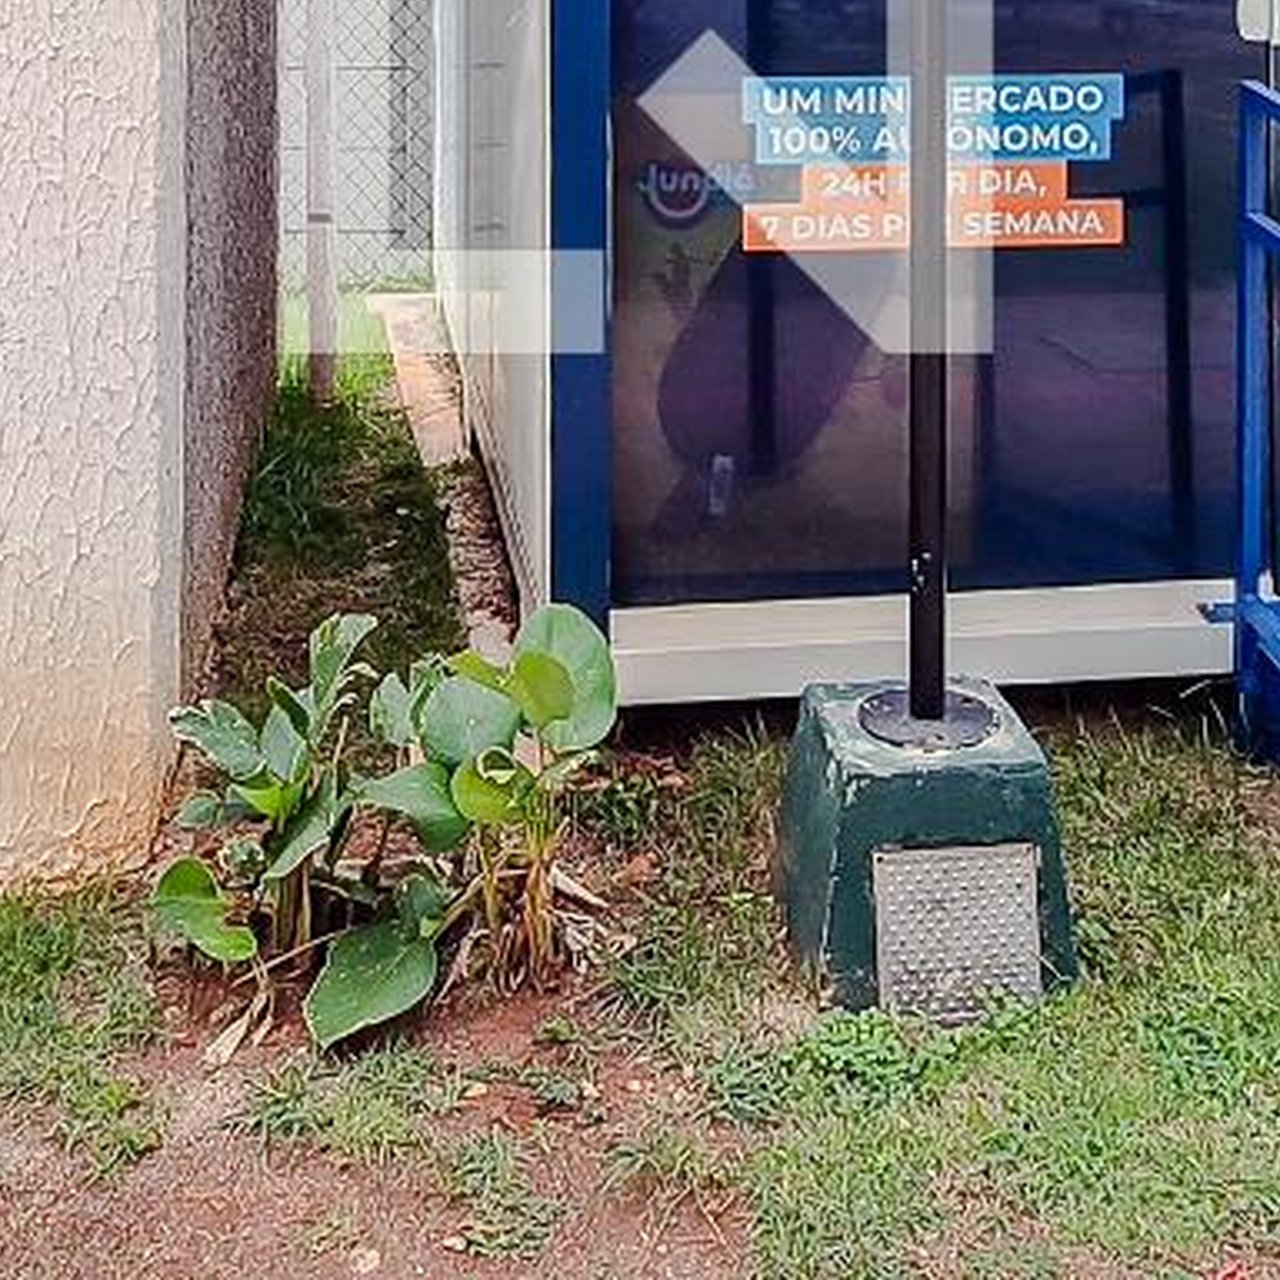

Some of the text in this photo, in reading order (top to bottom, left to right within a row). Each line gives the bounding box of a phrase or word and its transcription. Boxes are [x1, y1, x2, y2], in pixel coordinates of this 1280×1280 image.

[763, 84, 1104, 114] UM MINERCADO
[770, 118, 1099, 155] 100% AÔNOMO,
[821, 170, 886, 197] 24H
[979, 168, 1048, 198] DIA,
[759, 215, 779, 241] 7
[792, 213, 870, 240] DIAS
[964, 209, 1105, 236] SEMANA
